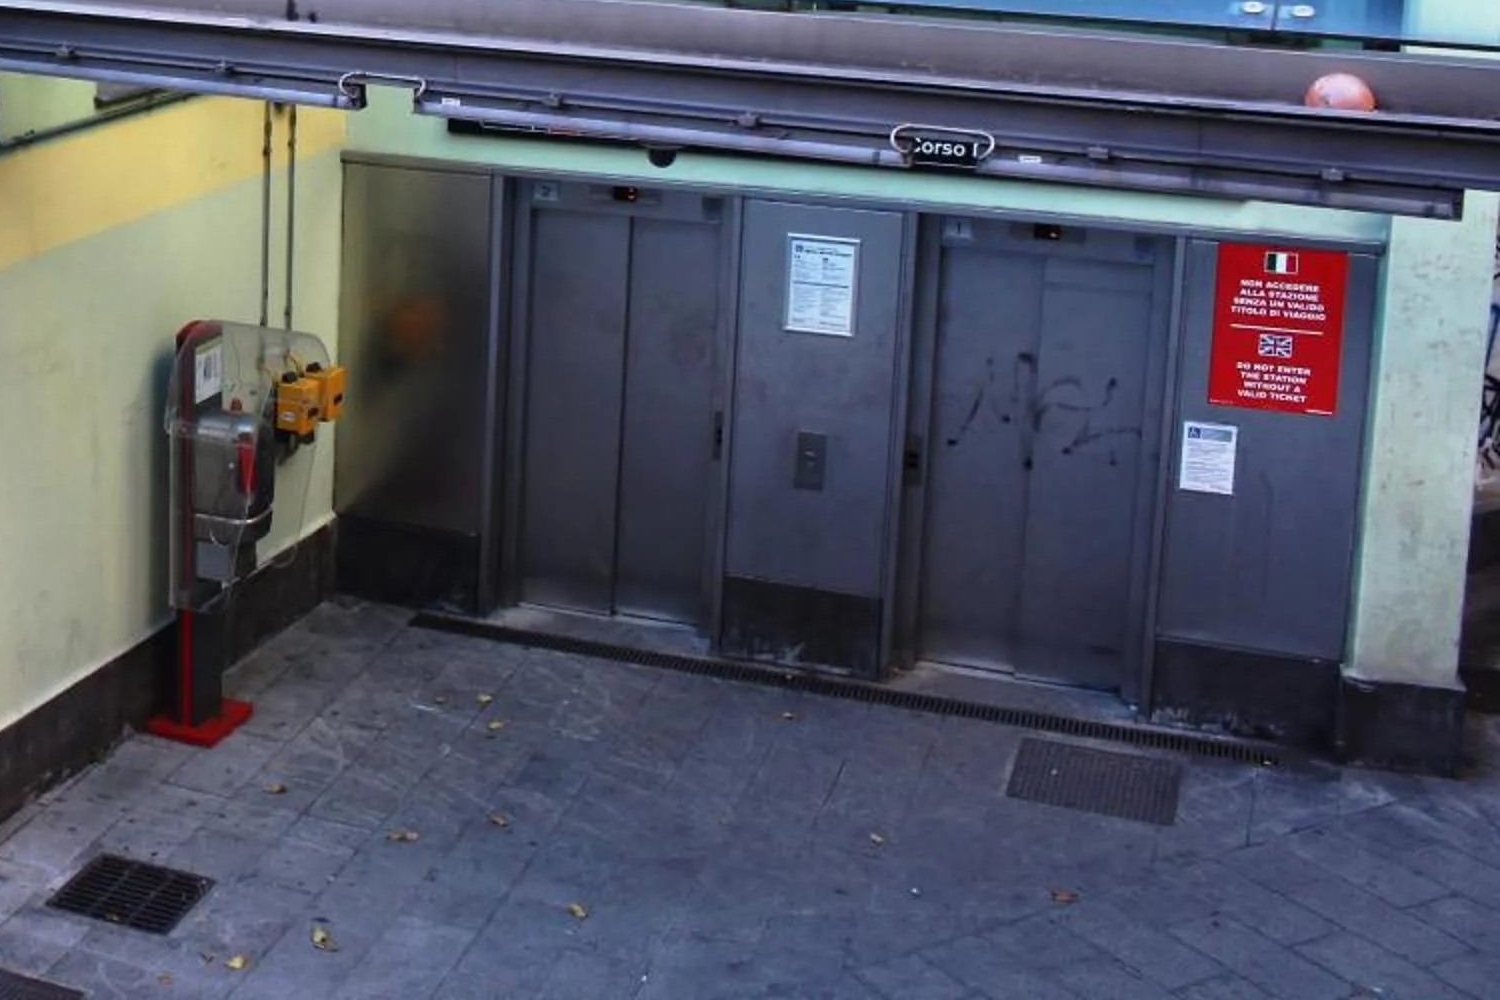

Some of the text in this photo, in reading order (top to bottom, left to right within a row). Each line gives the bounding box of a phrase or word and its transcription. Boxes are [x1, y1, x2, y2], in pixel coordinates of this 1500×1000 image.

[1240, 279, 1320, 293] NON ACCEDERE
[1240, 288, 1319, 302] ALLA STAZIONE
[1233, 296, 1267, 307] SENZA
[1286, 301, 1325, 312] VALIDO
[1231, 305, 1327, 321] TITOLO DI VIAGGIO
[1236, 361, 1312, 377] DO NOT ENTER
[1241, 370, 1307, 385] THE STATION
[1243, 380, 1302, 393] WITHOUT A
[1237, 388, 1307, 403] VALID TICKET
